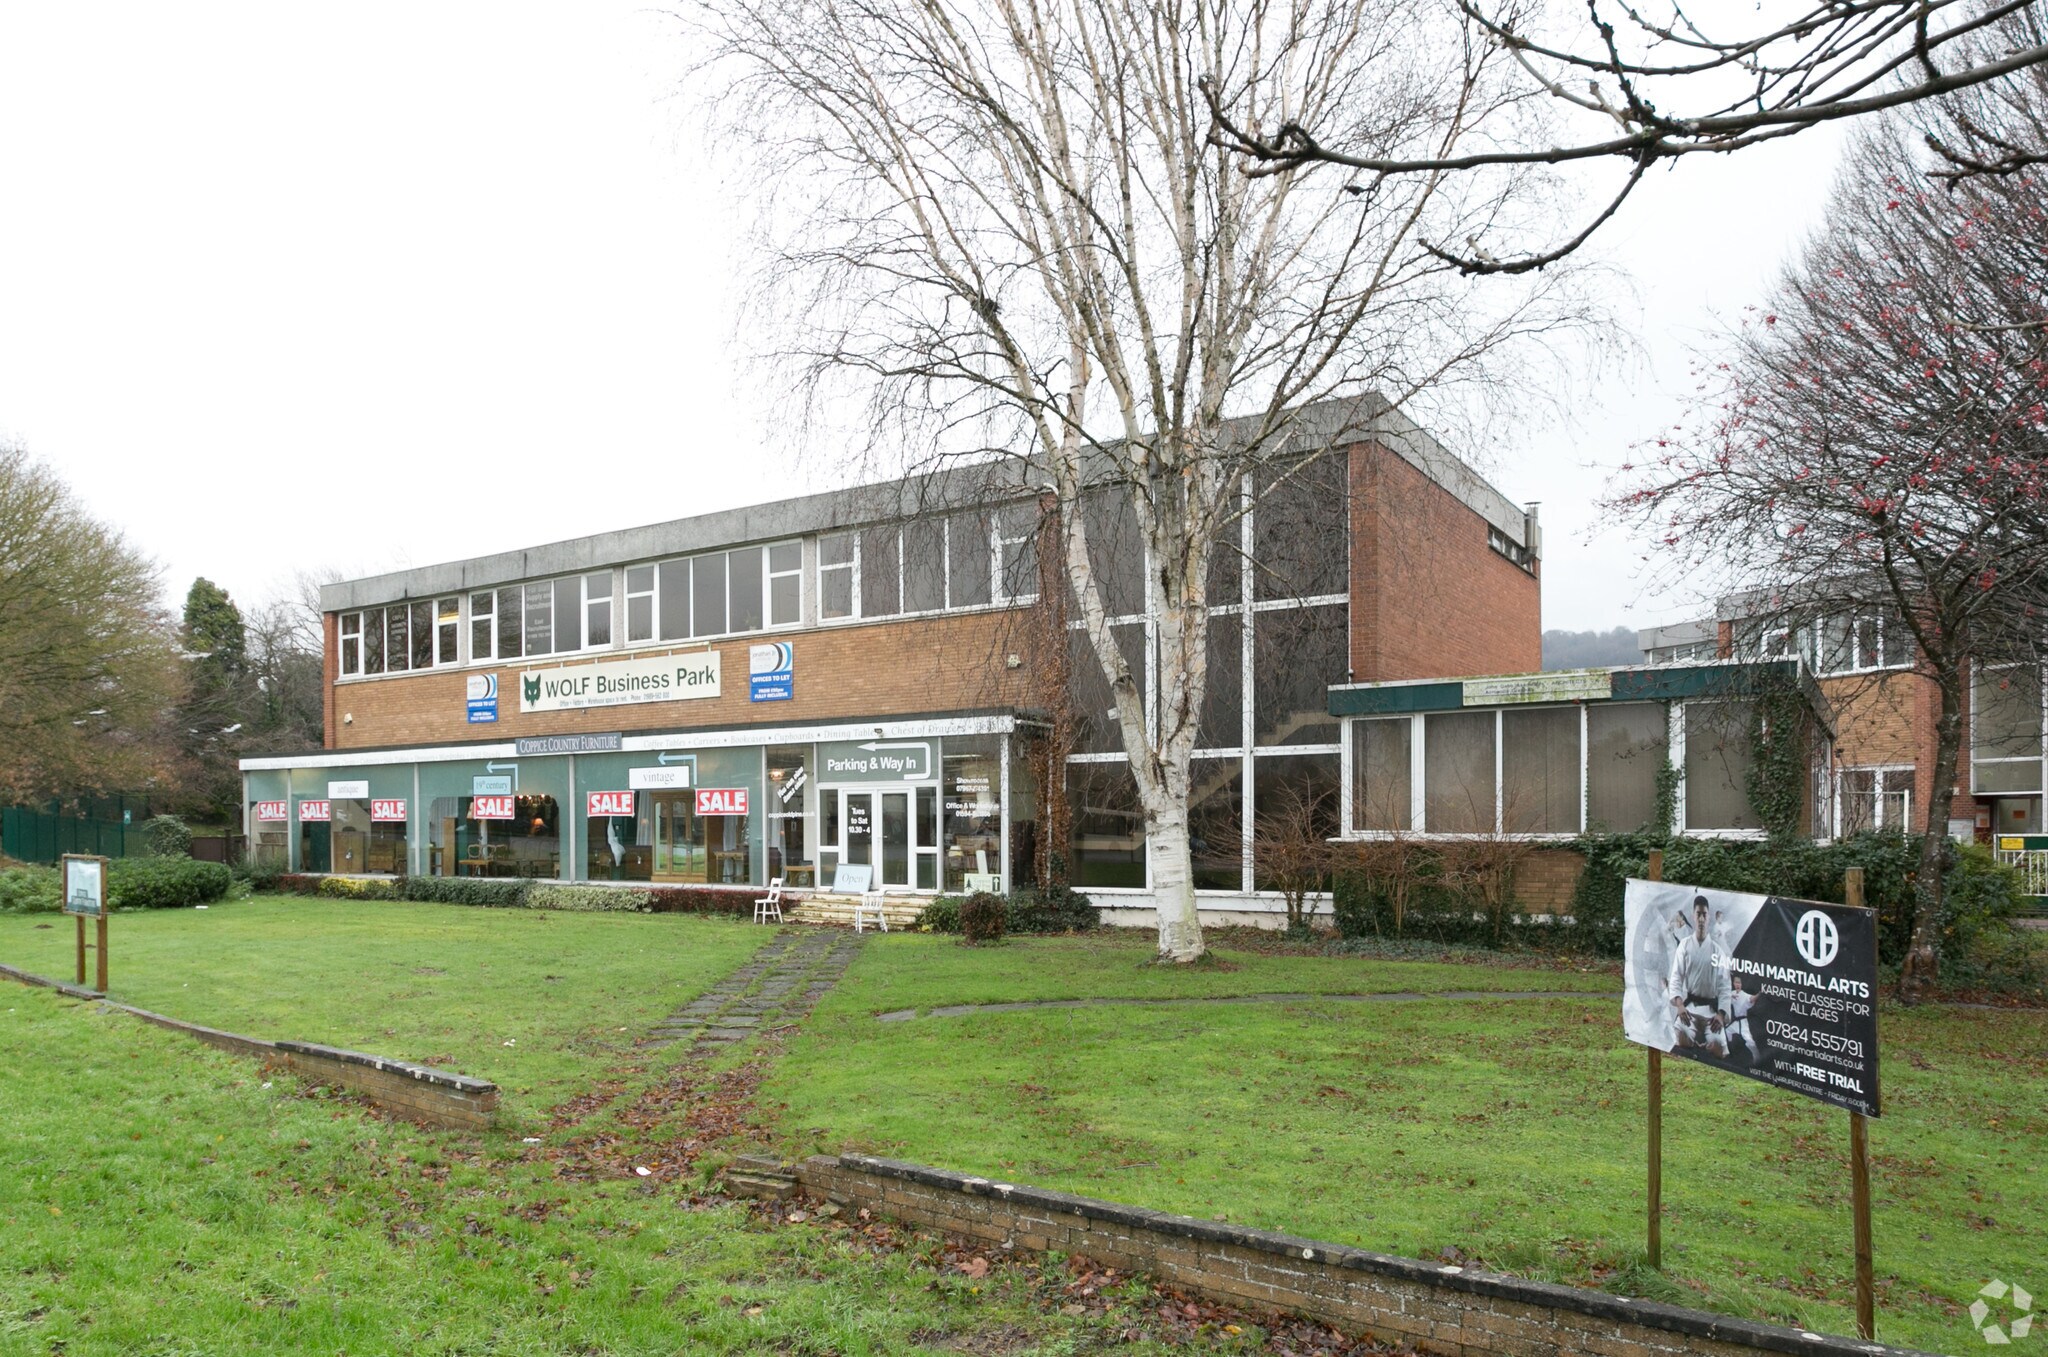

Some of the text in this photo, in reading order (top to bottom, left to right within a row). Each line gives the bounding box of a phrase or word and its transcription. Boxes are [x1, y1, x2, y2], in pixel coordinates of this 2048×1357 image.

[545, 666, 715, 698] WOLF Business Park
[774, 733, 814, 743] Cupboards
[824, 728, 850, 738] Dining
[853, 728, 877, 737] Table
[891, 726, 914, 735] Chest
[520, 736, 618, 753] COPPICE COUNTRY FURNITURE
[828, 757, 916, 773] Parking & Way In
[486, 782, 508, 791] century
[643, 772, 675, 786] vintage
[260, 802, 286, 818] SALE
[301, 801, 329, 818] SALE
[374, 801, 405, 818] SALE
[477, 798, 512, 816] SALE
[591, 793, 632, 814] SALE
[699, 792, 746, 812] SALE
[842, 873, 863, 885] Open
[1711, 953, 1869, 998] SAMURAI MARTIAL ARTS
[1761, 983, 1870, 1017] KARATE CLASSES FOR
[1790, 1002, 1839, 1023] ALL AGES
[1766, 1019, 1864, 1058] 07824 555791
[1767, 1038, 1864, 1071] samurai-martialarts.co.uk
[1762, 1071, 1772, 1080] THE
[1802, 1083, 1823, 1096] CENTRE
[1774, 1059, 1864, 1094] WITH FREE TRIAL
